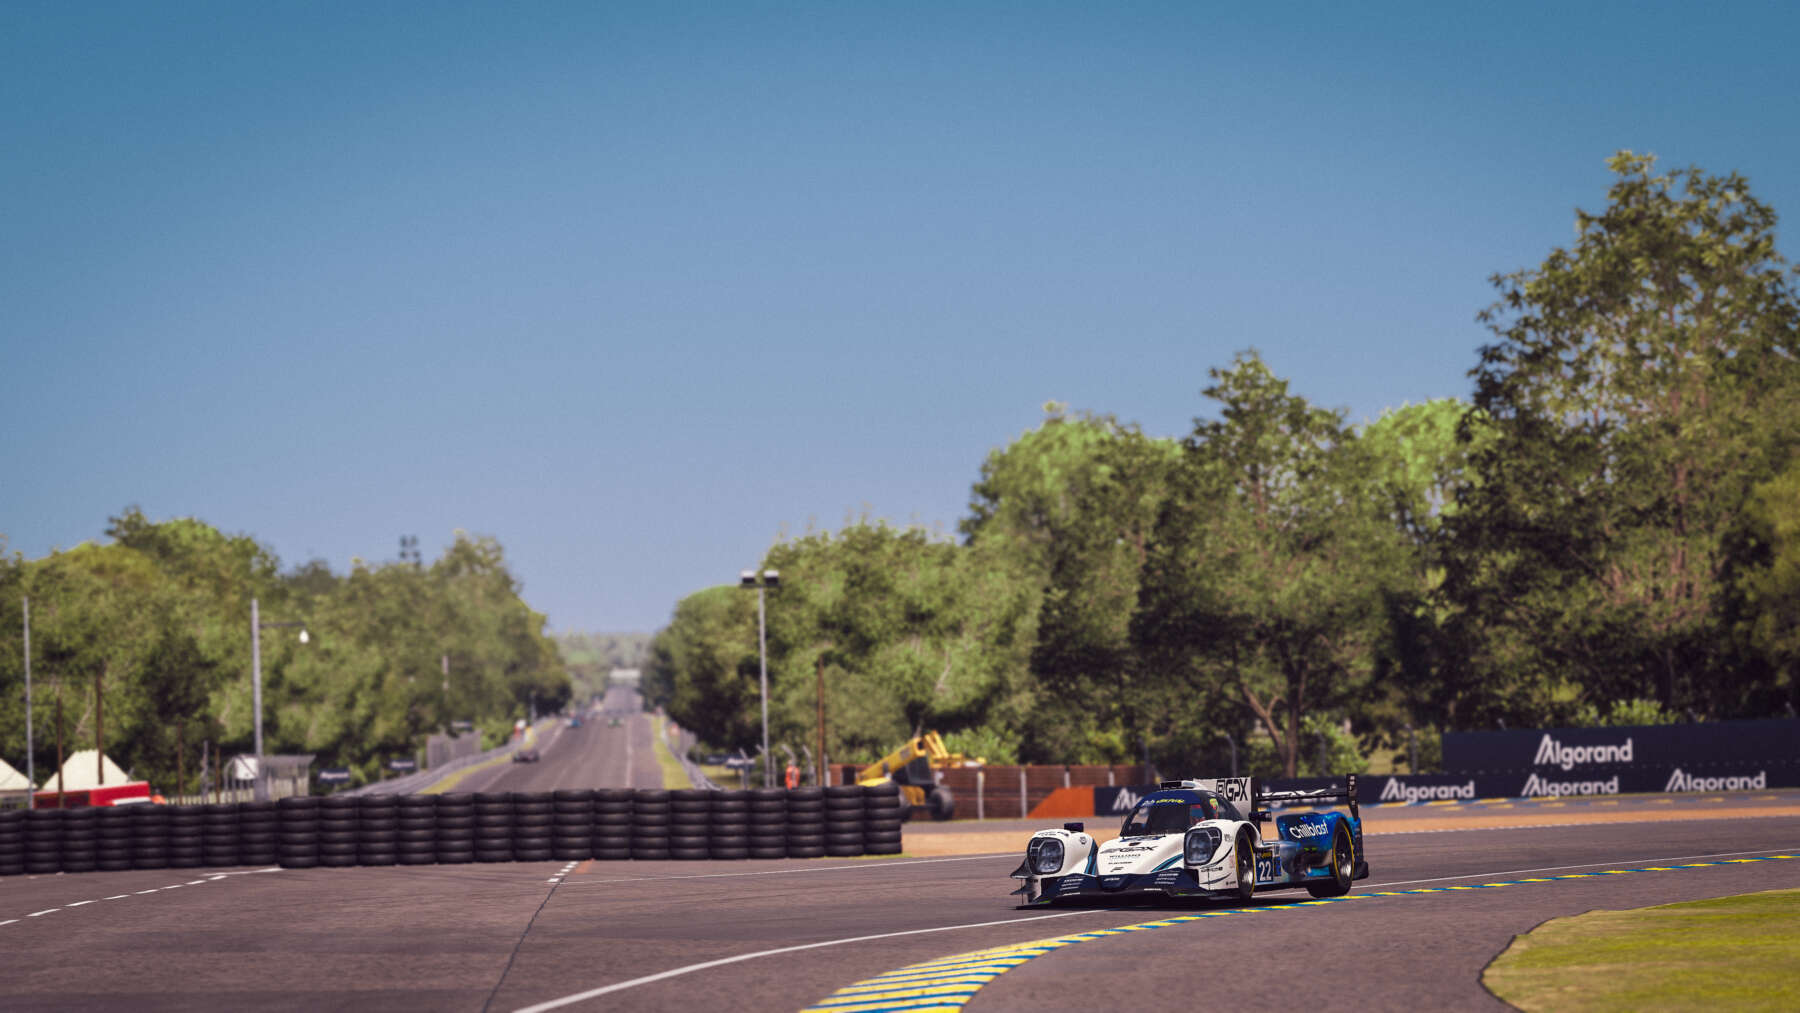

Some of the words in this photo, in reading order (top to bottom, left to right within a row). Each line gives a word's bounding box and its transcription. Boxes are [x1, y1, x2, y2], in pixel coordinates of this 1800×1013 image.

[1534, 734, 1633, 769] Algorand
[1380, 777, 1475, 803] Algorand
[1521, 774, 1619, 797] Algorand
[1665, 768, 1766, 791] Algorand
[1289, 819, 1329, 838] Chillblast
[1258, 860, 1272, 881] 22
